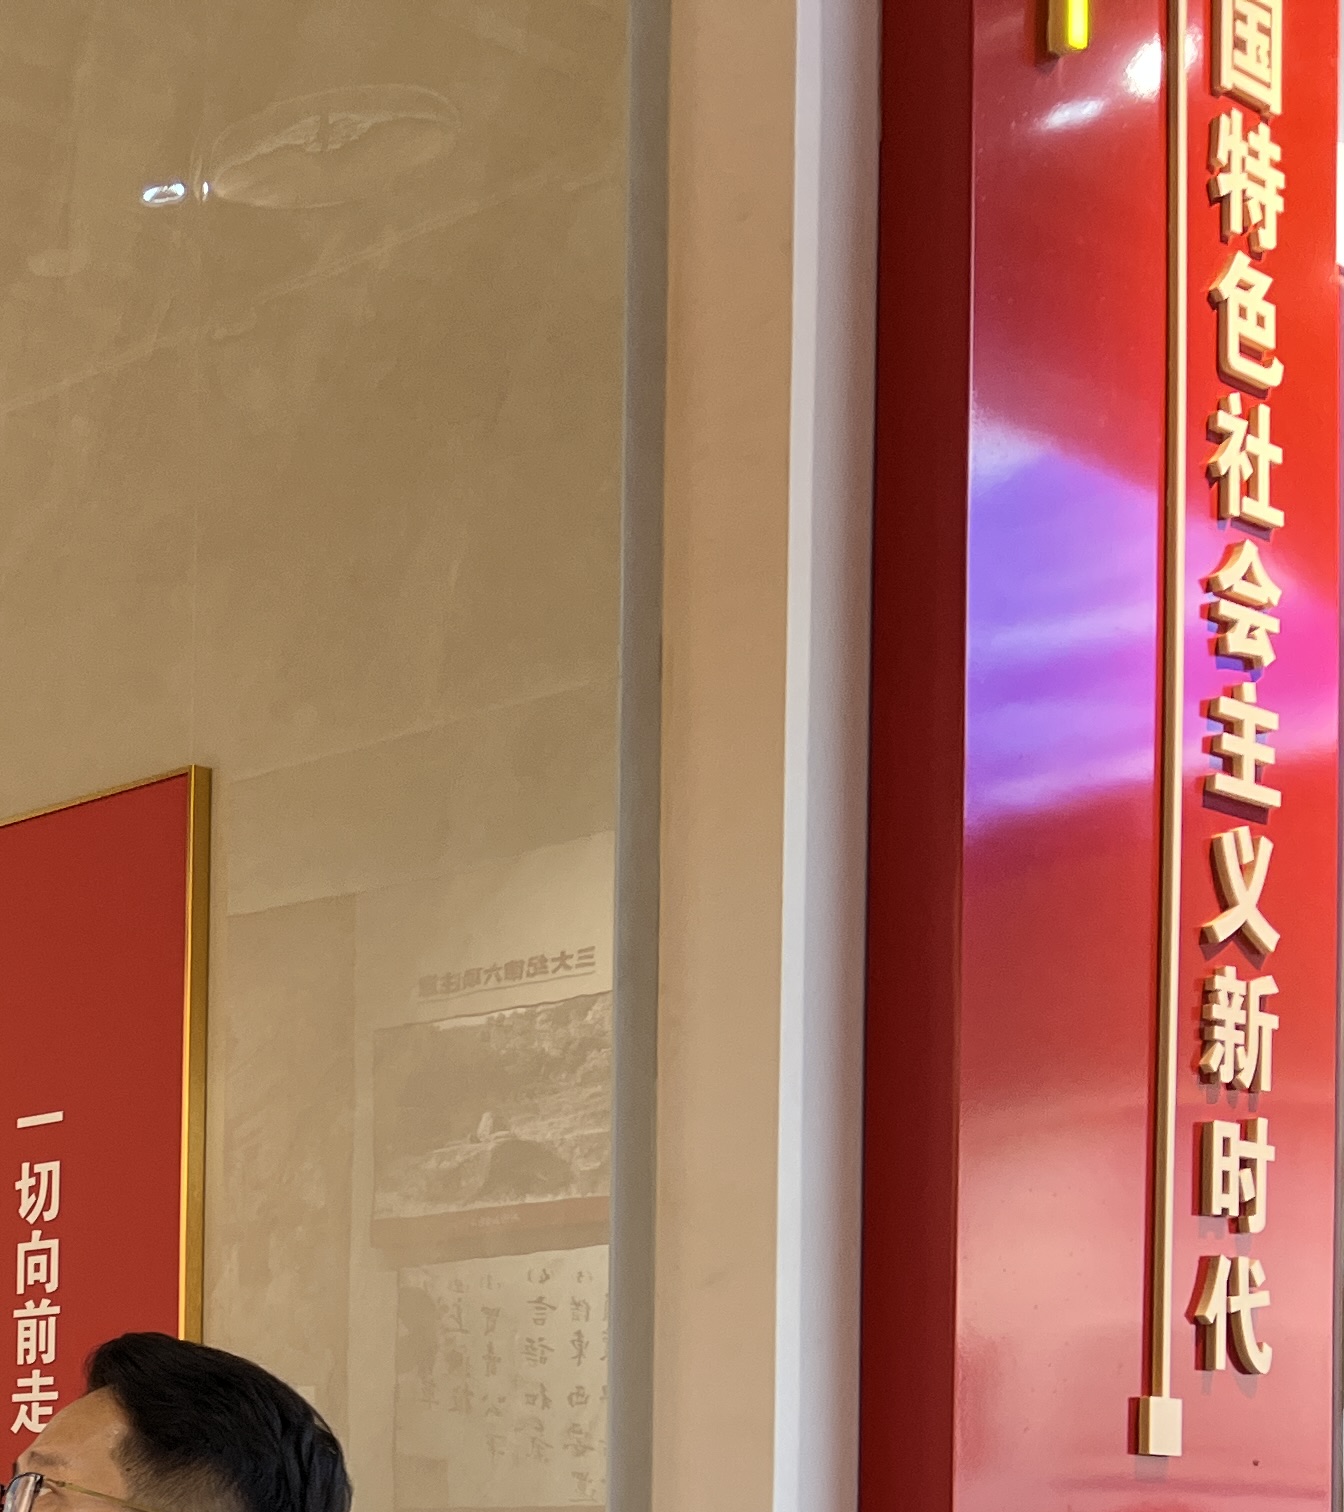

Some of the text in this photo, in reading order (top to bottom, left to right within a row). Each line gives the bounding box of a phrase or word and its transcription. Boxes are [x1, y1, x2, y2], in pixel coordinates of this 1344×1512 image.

[1196, 0, 1284, 1374] 国特色社会主义新时代
